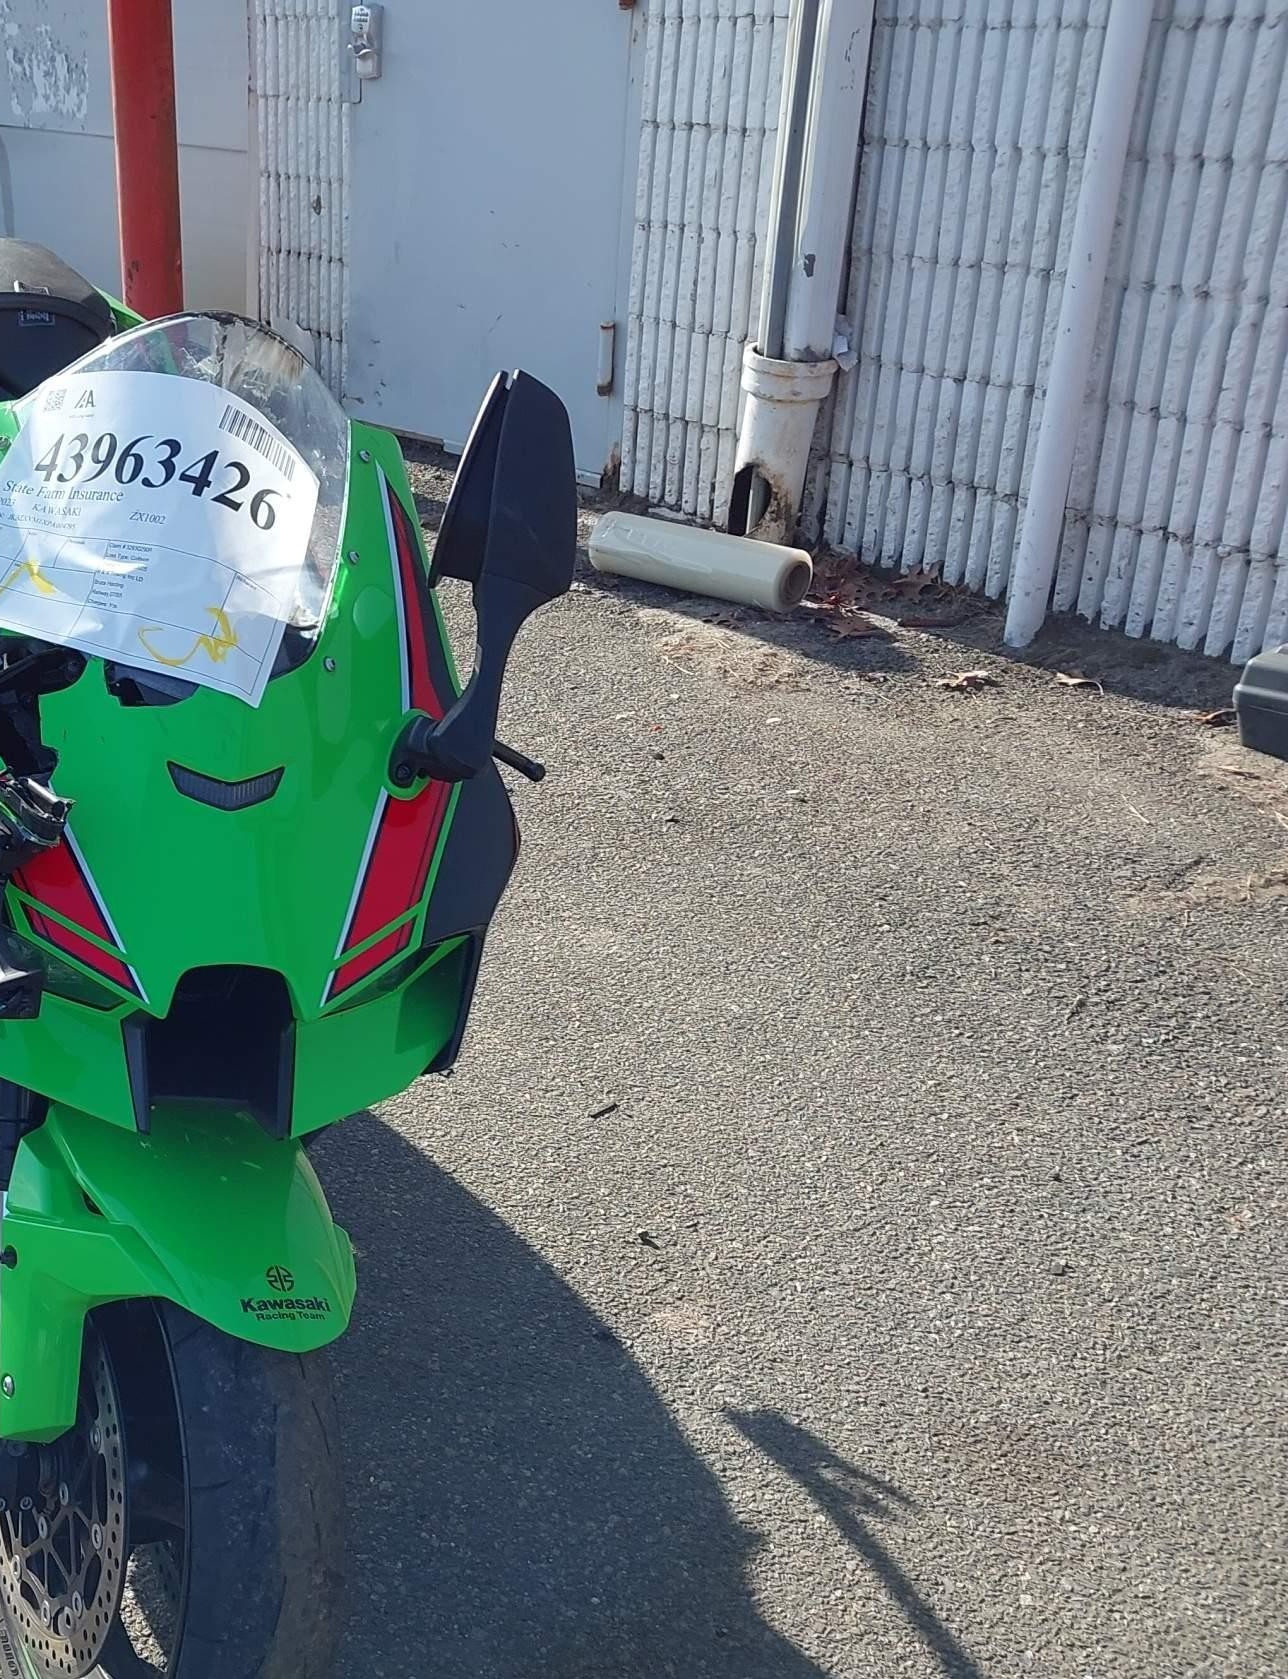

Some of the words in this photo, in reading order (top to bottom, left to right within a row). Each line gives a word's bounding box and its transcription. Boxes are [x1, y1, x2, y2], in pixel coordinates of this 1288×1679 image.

[3, 480, 34, 495] State
[36, 486, 65, 501] Farm
[68, 487, 124, 502] Insurance
[34, 432, 284, 531] 43963426
[32, 503, 82, 517] KAWASAKI
[129, 510, 166, 525] ZX1002
[240, 1297, 331, 1312] Kawasaki
[256, 1311, 295, 1321] Racing
[296, 1311, 325, 1320] Team
